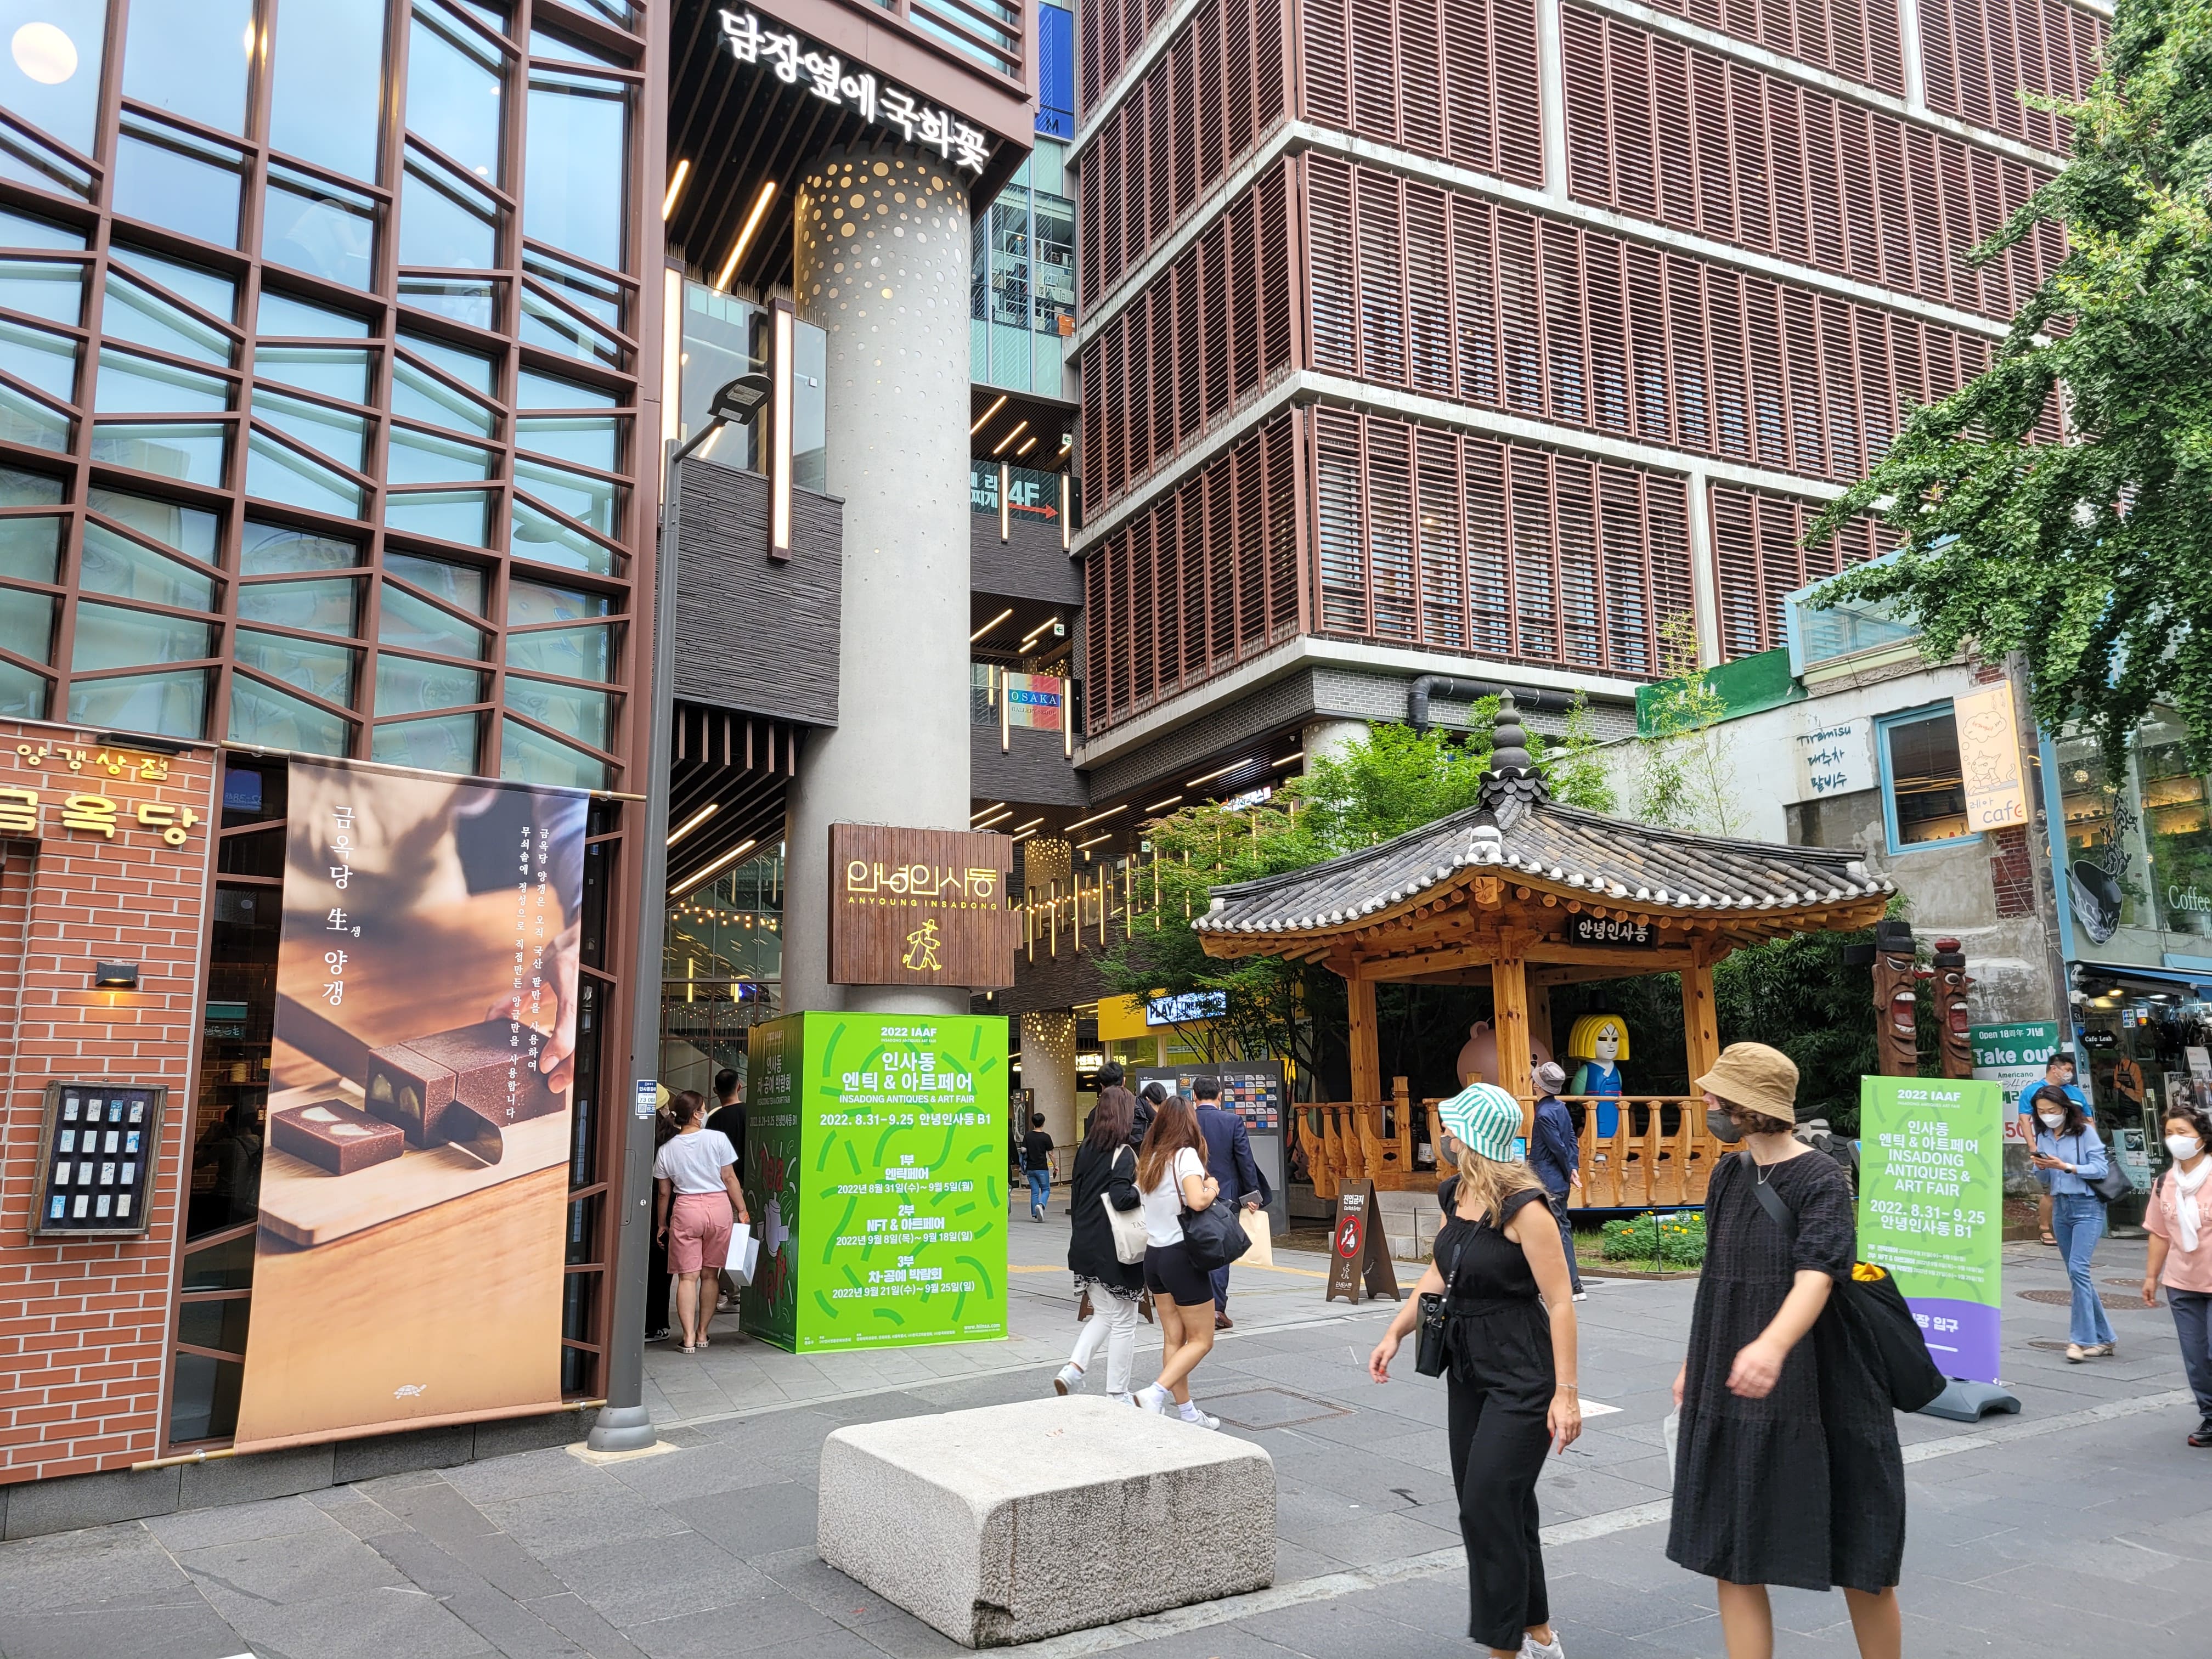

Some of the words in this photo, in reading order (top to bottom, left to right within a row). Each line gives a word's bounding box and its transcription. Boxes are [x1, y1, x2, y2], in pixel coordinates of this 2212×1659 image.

[718, 8, 876, 124] 담장옆에
[881, 85, 991, 175] 국화꽃
[1008, 481, 1040, 507] 4F
[1011, 691, 1057, 704] OSAKA
[1796, 726, 1851, 747] Tiramisu
[16, 744, 169, 781] 양갱상점
[1808, 747, 1845, 766] 대추차
[1970, 797, 1994, 809] 레아
[0, 788, 199, 845] 금옥당
[329, 805, 356, 889] 금옥당
[519, 826, 531, 876] 무쇠솥에
[538, 828, 550, 865] 금옥당
[847, 860, 997, 898] 안녕인사동
[536, 871, 548, 907] 양갱은
[2168, 884, 2212, 913] Coffee
[516, 882, 527, 931] 정성으로
[848, 896, 918, 907] ANYOUNG
[924, 900, 997, 910] INSADONG
[326, 907, 348, 932] 生
[535, 915, 545, 939] 오직
[1578, 919, 1649, 943] 안녕인사동
[533, 946, 544, 969] 국산
[321, 949, 348, 1006] 양갱
[531, 976, 542, 1014] 팥만을
[510, 996, 522, 1047] 앙금만을
[881, 1027, 908, 1036] 2022
[911, 1028, 937, 1037] IAAF
[1979, 1031, 1998, 1040] Open
[2026, 1027, 2044, 1037] 기념
[527, 1021, 540, 1072] 사용하여
[1973, 1047, 2017, 1065] Take
[2023, 1045, 2057, 1063] out
[766, 1054, 782, 1074] 인사동
[882, 1052, 936, 1071] 인사동
[775, 1073, 791, 1093] 박람회
[842, 1071, 878, 1092] 엔틱
[883, 1074, 896, 1090] &
[901, 1072, 973, 1092] 아트페어
[839, 1094, 885, 1103] INSADONG
[886, 1094, 929, 1104] ANTIQUES
[930, 1095, 936, 1103] &
[937, 1094, 955, 1103] ART
[956, 1094, 975, 1104] FAIR
[1897, 1089, 1927, 1100] 2022
[1931, 1091, 1961, 1102] IAAF
[776, 1114, 792, 1127] 안녕인사동
[820, 1113, 852, 1126] 2022.
[919, 1113, 975, 1126] 안녕인사동
[978, 1113, 991, 1124] B1
[1908, 1120, 1949, 1136] 인사동
[1879, 1133, 1905, 1149] 엔틱
[1908, 1137, 1918, 1147] &
[1921, 1136, 1978, 1154] 아트페어
[900, 1154, 915, 1166] 1부
[1888, 1149, 1964, 1167] INSADONG
[1884, 1164, 1957, 1182] ANTIQUES
[1960, 1171, 1971, 1182] &
[837, 1184, 867, 1194] 2022년
[868, 1183, 883, 1194] 8월
[930, 1182, 943, 1192] 9월
[944, 1181, 974, 1192] 5일(월)
[1894, 1179, 1923, 1193] ART
[1926, 1182, 1960, 1198] FAIR
[1343, 1194, 1364, 1205] 진입금지
[1870, 1199, 1908, 1216] 2022.
[898, 1204, 915, 1217] 2부
[866, 1218, 888, 1232] NFT
[890, 1218, 898, 1231] &
[901, 1217, 945, 1231] 아트페어
[1880, 1214, 1951, 1237] 안녕인사동
[1954, 1224, 1972, 1239] B1
[836, 1235, 866, 1246] 2022년
[867, 1234, 882, 1245] 9월
[923, 1233, 937, 1243] 9월
[939, 1231, 973, 1242] 18일(일)
[897, 1255, 914, 1267] 3부
[868, 1269, 906, 1284] 차·공예
[909, 1267, 943, 1282] 박람회
[832, 1288, 863, 1299] 2022년
[864, 1286, 879, 1297] 9월
[925, 1284, 939, 1294] 9월
[941, 1281, 975, 1293] 25일(일)
[1933, 1317, 1959, 1333] 입구
